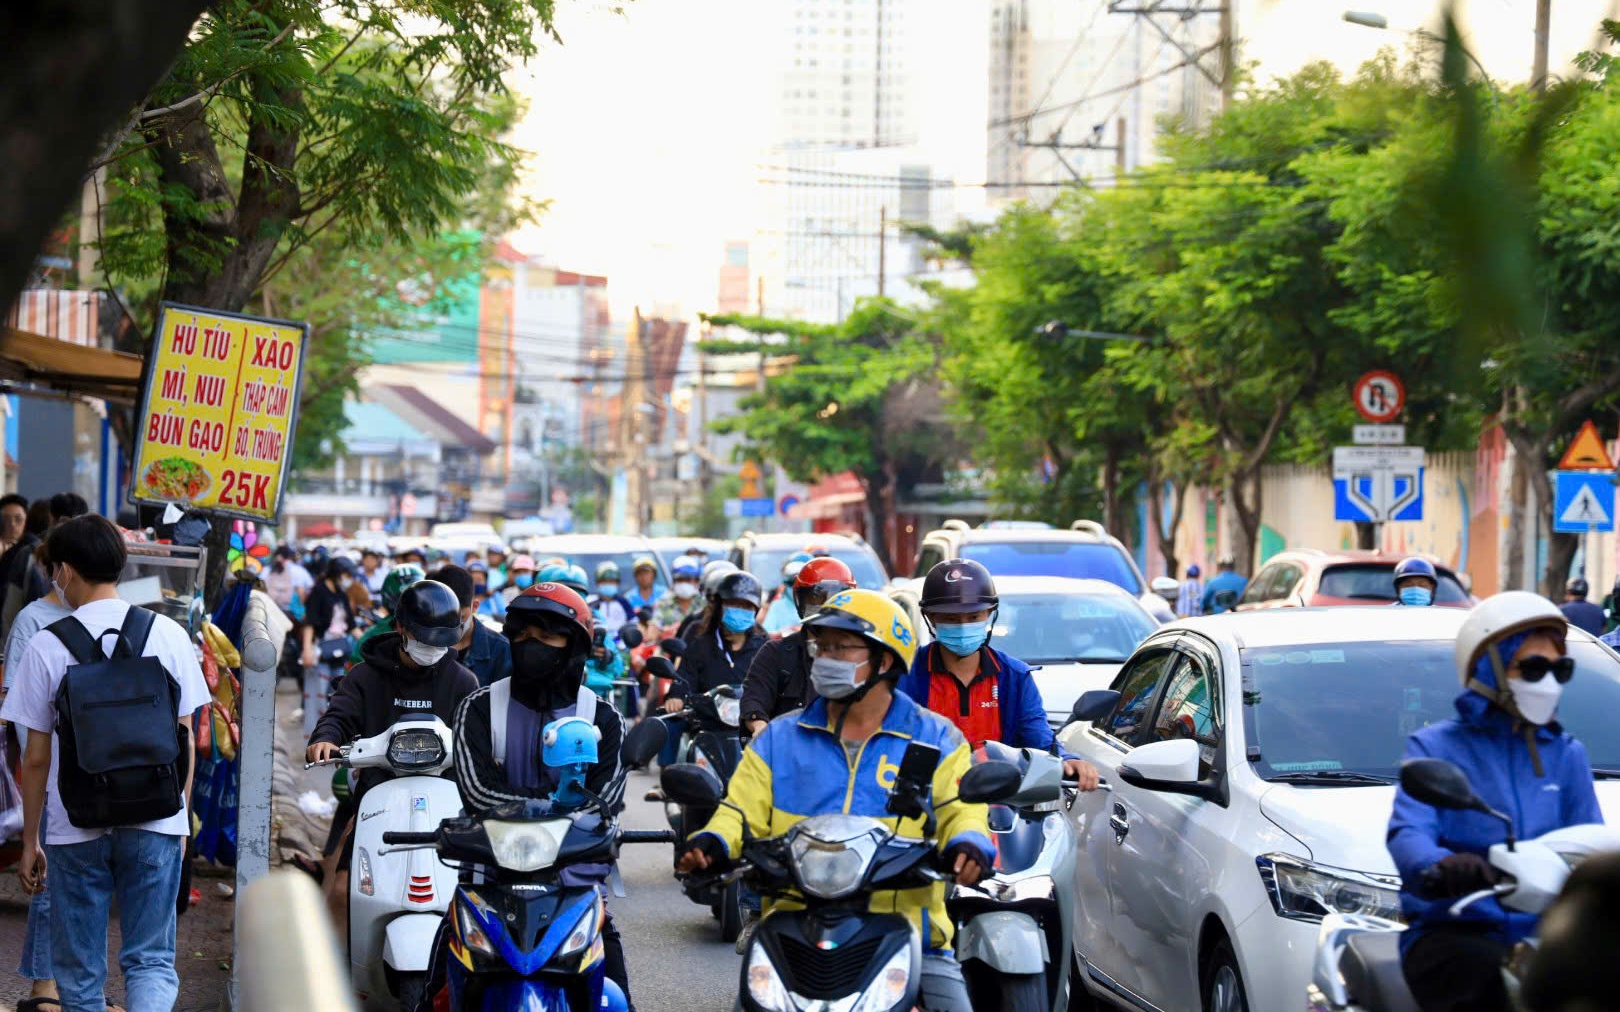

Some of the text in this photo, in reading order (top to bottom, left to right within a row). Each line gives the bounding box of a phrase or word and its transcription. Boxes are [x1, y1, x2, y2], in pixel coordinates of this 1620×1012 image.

[172, 317, 231, 361] HỦ TÍU
[251, 331, 294, 371] XÀO
[161, 364, 226, 407] MÌ, NUI
[148, 407, 224, 457] BÚN GẠO
[218, 469, 271, 510] 25K
[891, 613, 912, 647] be
[512, 884, 547, 892] HONDA
